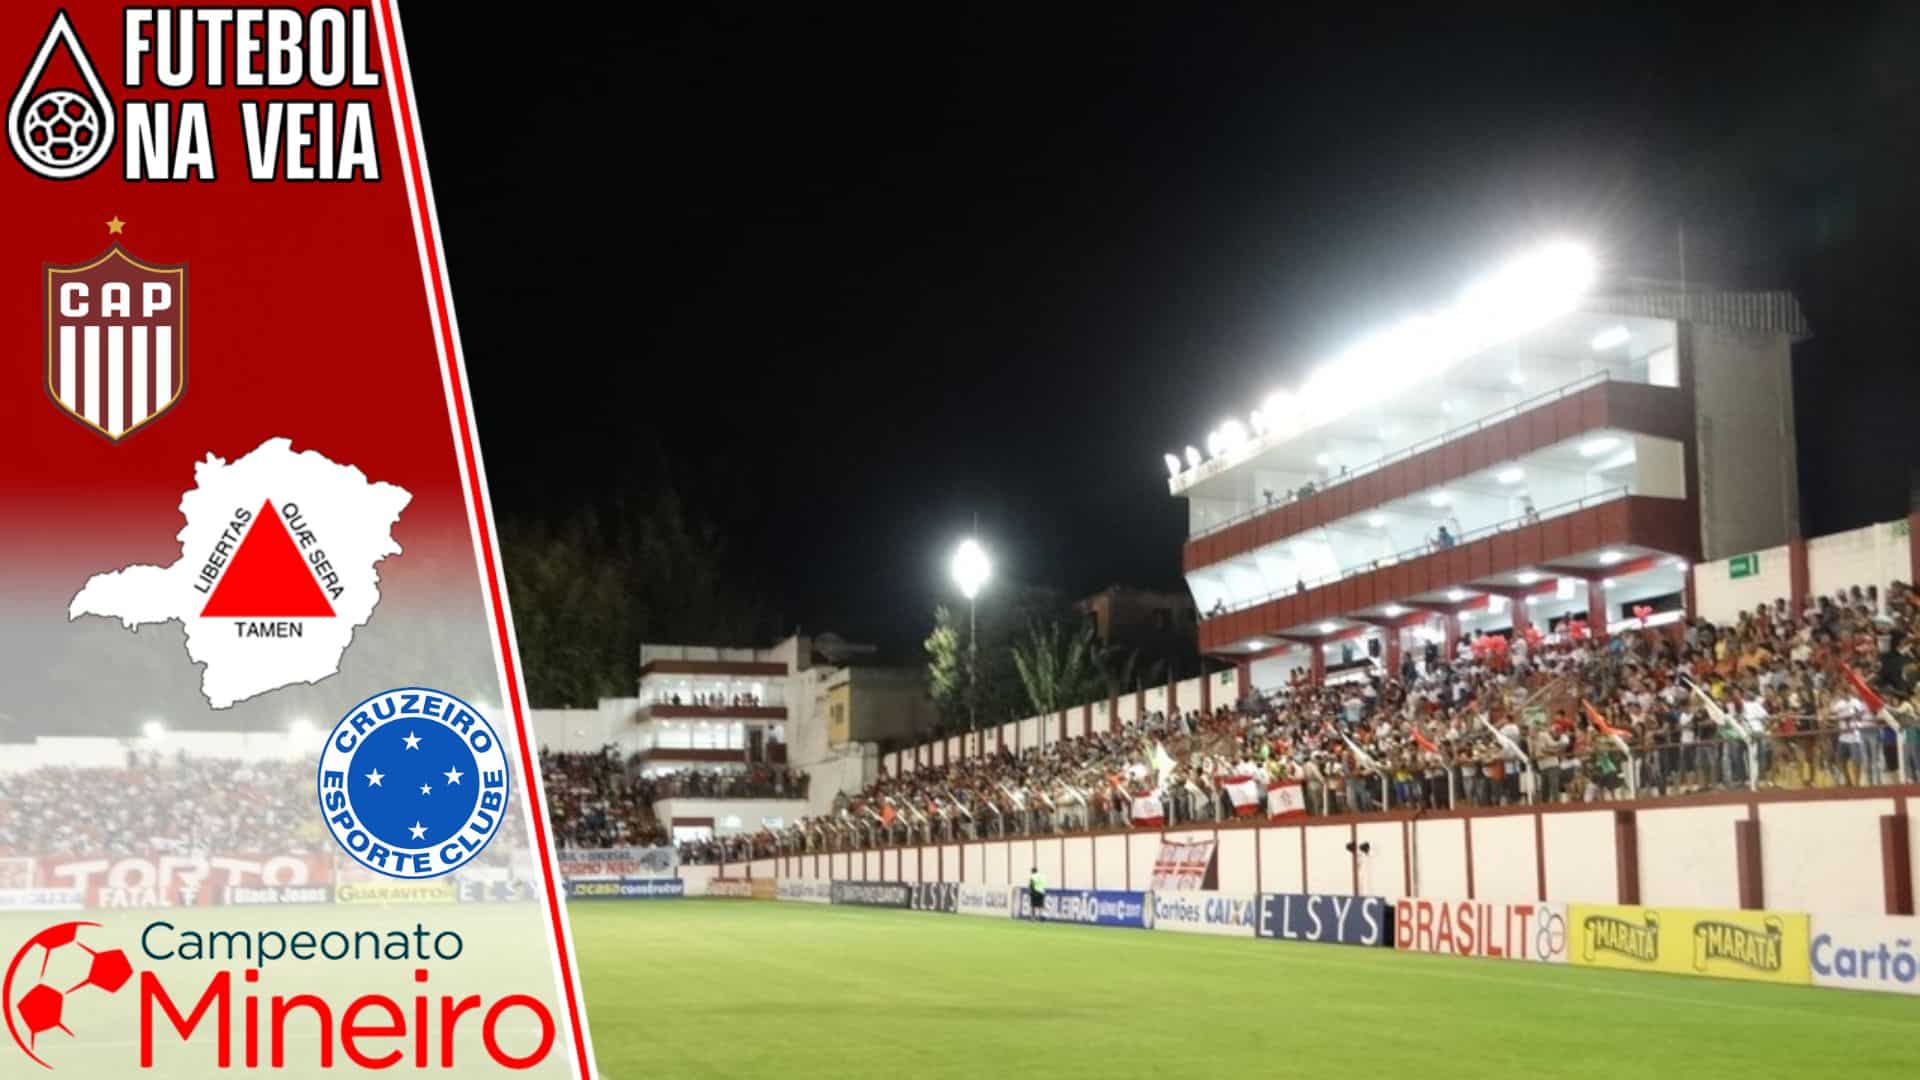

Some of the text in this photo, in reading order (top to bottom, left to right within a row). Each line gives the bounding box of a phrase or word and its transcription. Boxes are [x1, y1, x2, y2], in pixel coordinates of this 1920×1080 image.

[911, 882, 959, 912] ELSYS
[1022, 890, 1098, 922] BSILEIRÃO
[1154, 895, 1200, 922] Cartões
[1206, 898, 1255, 928] CAIXA
[1259, 894, 1379, 945] ELSYS
[1396, 899, 1534, 959] BRASILIT
[1810, 932, 1917, 984] Cartõ
